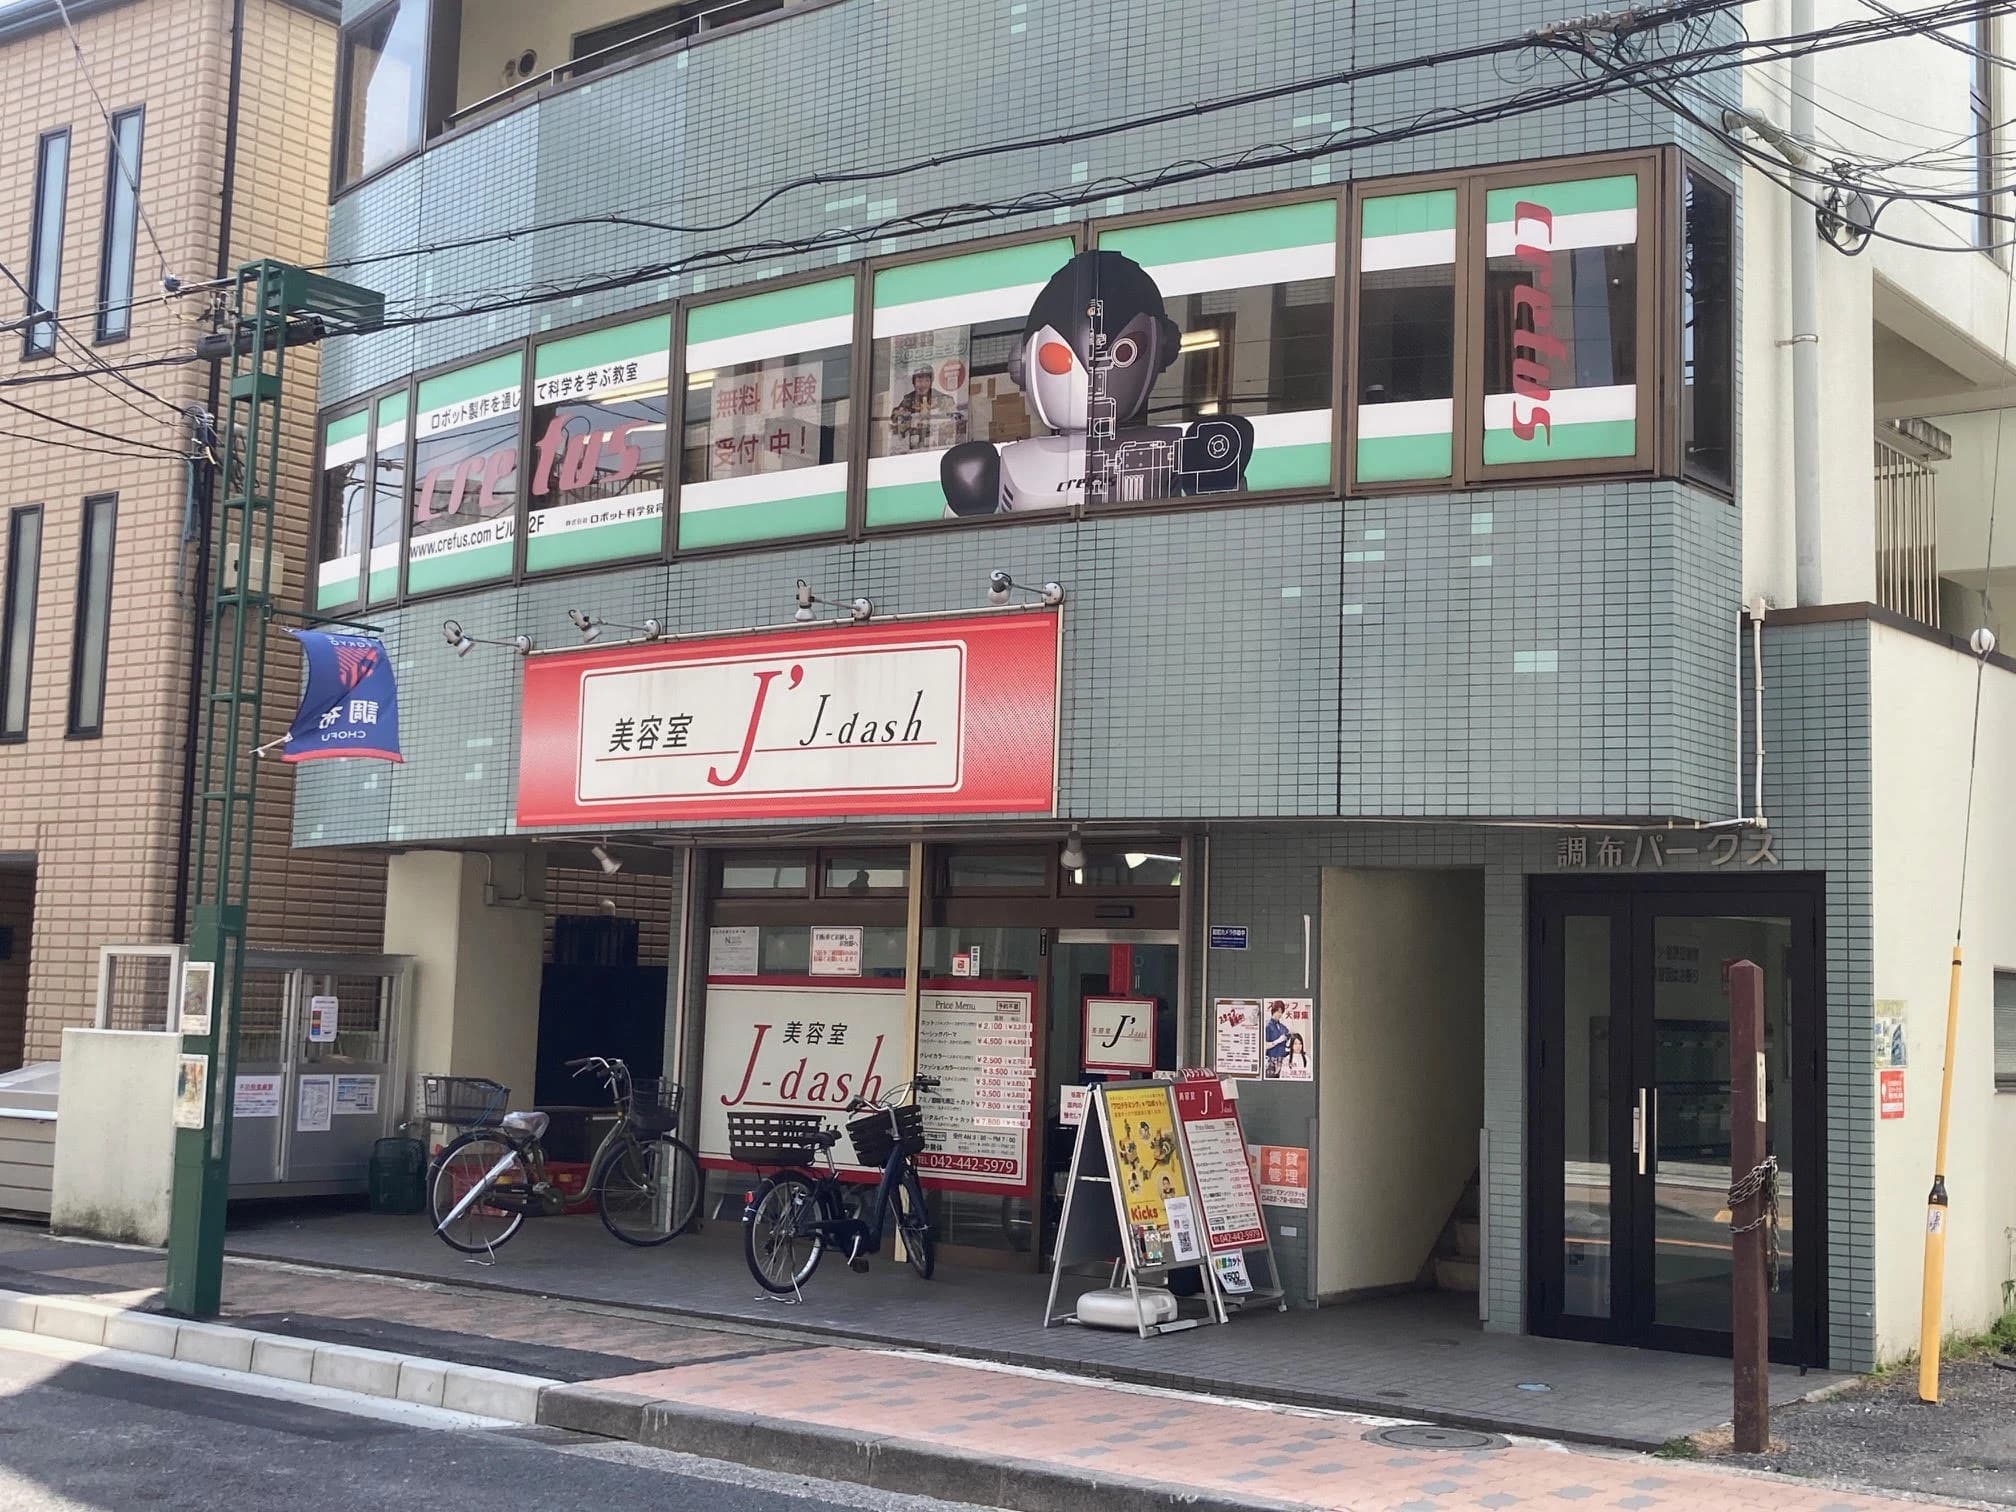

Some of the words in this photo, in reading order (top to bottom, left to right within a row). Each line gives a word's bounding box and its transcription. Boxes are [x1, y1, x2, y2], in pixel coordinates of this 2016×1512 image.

[409, 527, 492, 559] www.crefus.com
[609, 712, 694, 754] 美容室
[799, 689, 924, 747] J-dash
[1557, 834, 1778, 868] 調布パークス
[935, 1000, 953, 1010] Price
[954, 1001, 976, 1011] Menu
[782, 1020, 848, 1046] 美容室
[720, 1024, 885, 1106] J-dash
[930, 1155, 1014, 1174] 042-442-5979
[1130, 1205, 1159, 1221] Kicks
